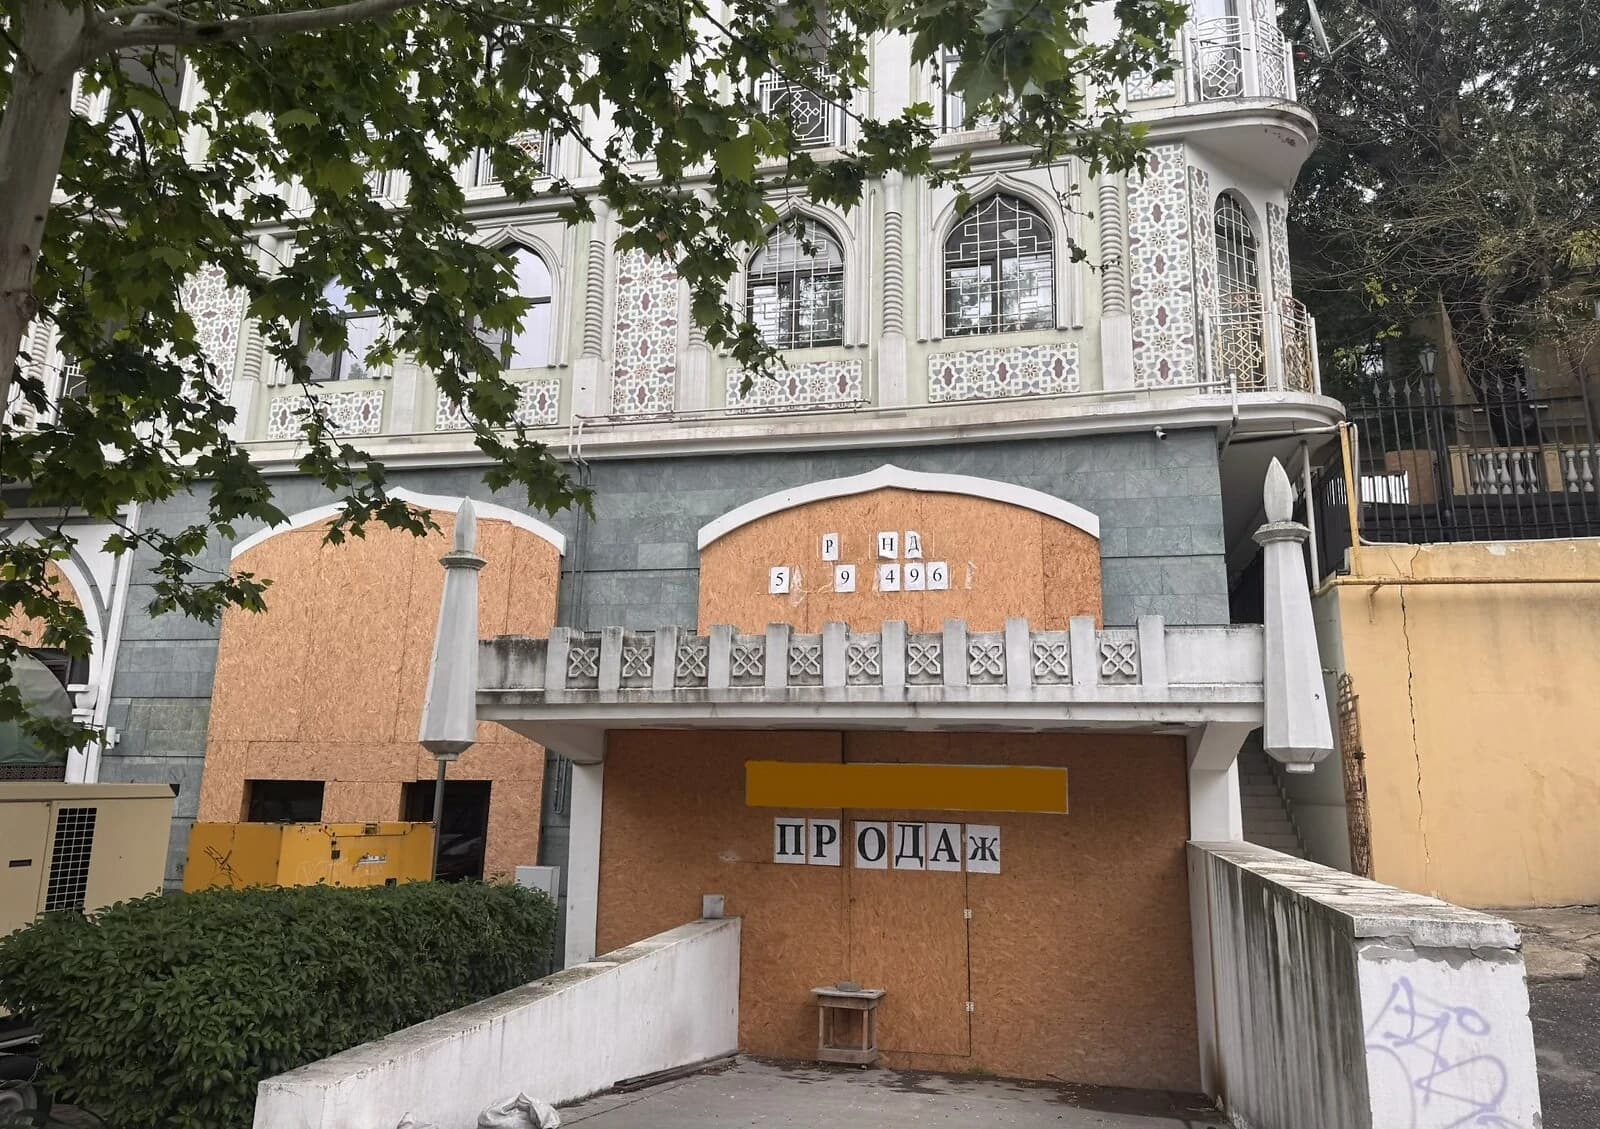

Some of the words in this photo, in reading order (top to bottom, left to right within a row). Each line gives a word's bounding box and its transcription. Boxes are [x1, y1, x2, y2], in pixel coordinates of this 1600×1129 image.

[775, 572, 785, 587] 5
[841, 570, 850, 585] 9
[885, 568, 942, 584] 496
